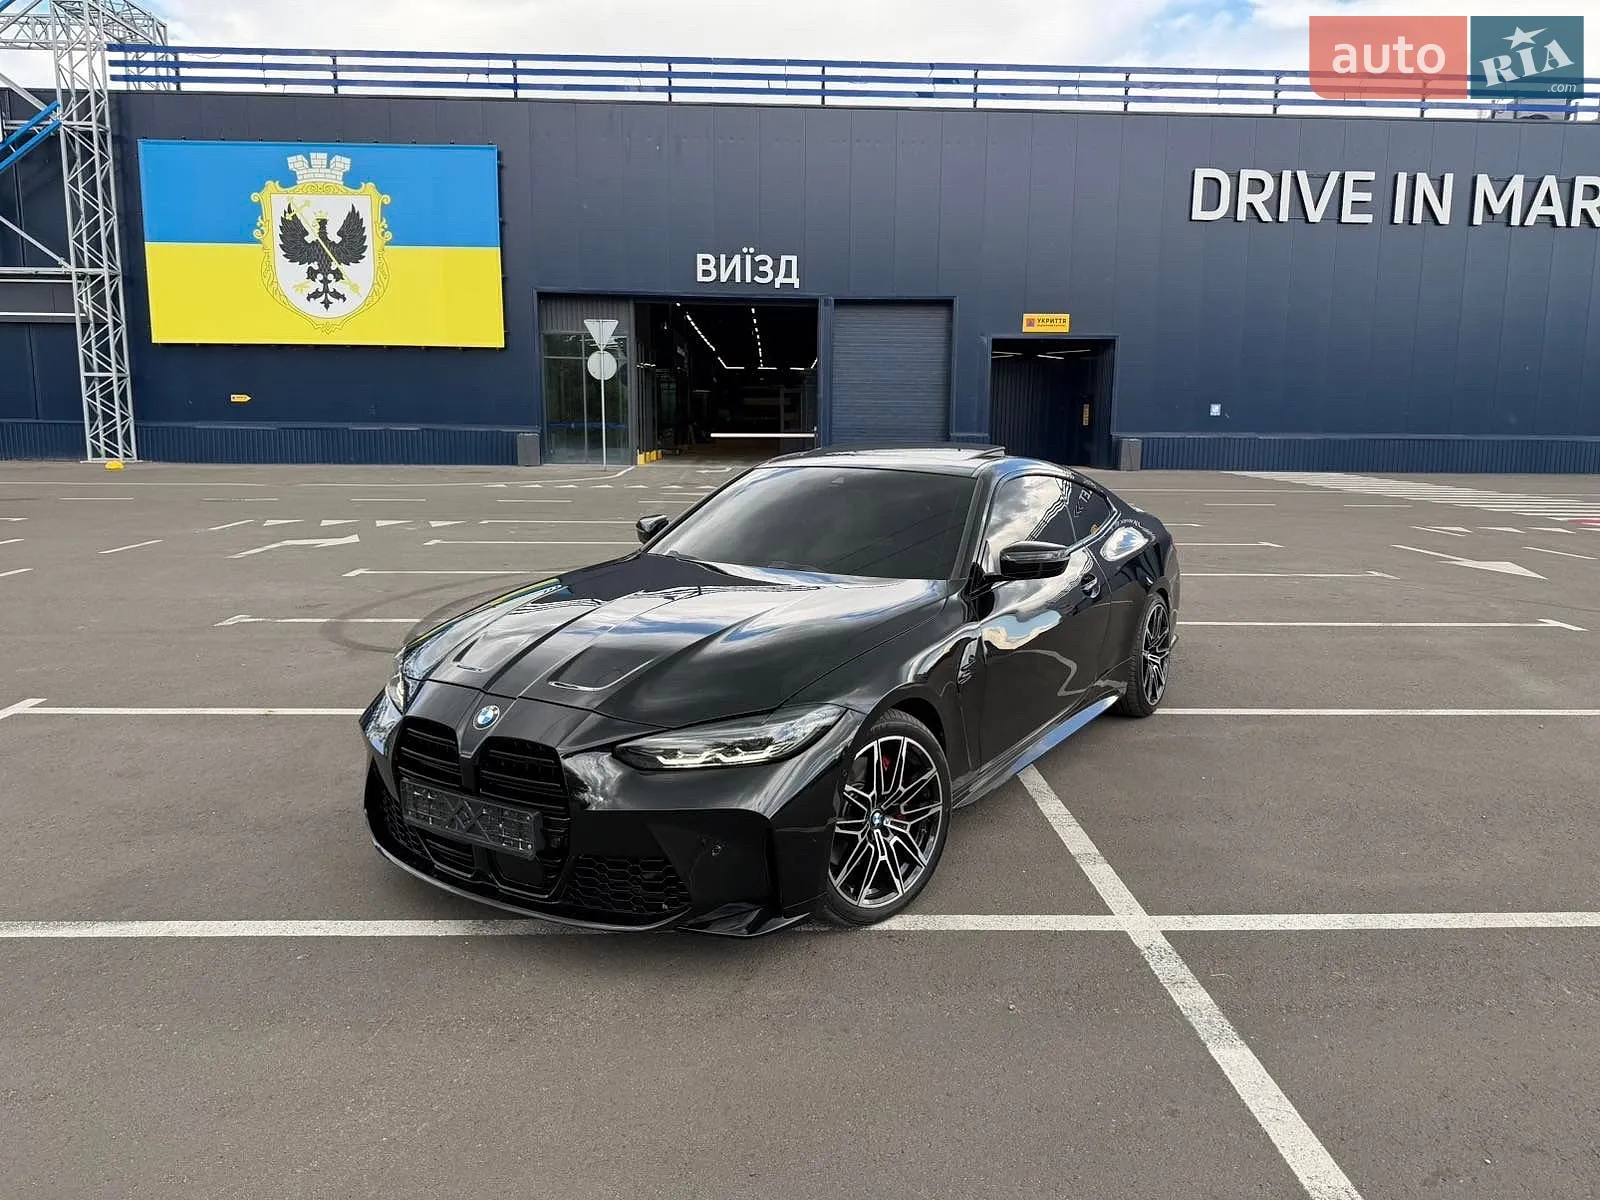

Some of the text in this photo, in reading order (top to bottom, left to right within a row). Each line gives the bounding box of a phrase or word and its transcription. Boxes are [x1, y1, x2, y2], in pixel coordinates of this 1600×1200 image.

[1190, 168, 1600, 227] DRIVE IN MAR
[696, 246, 800, 289] ВИЇЗД
